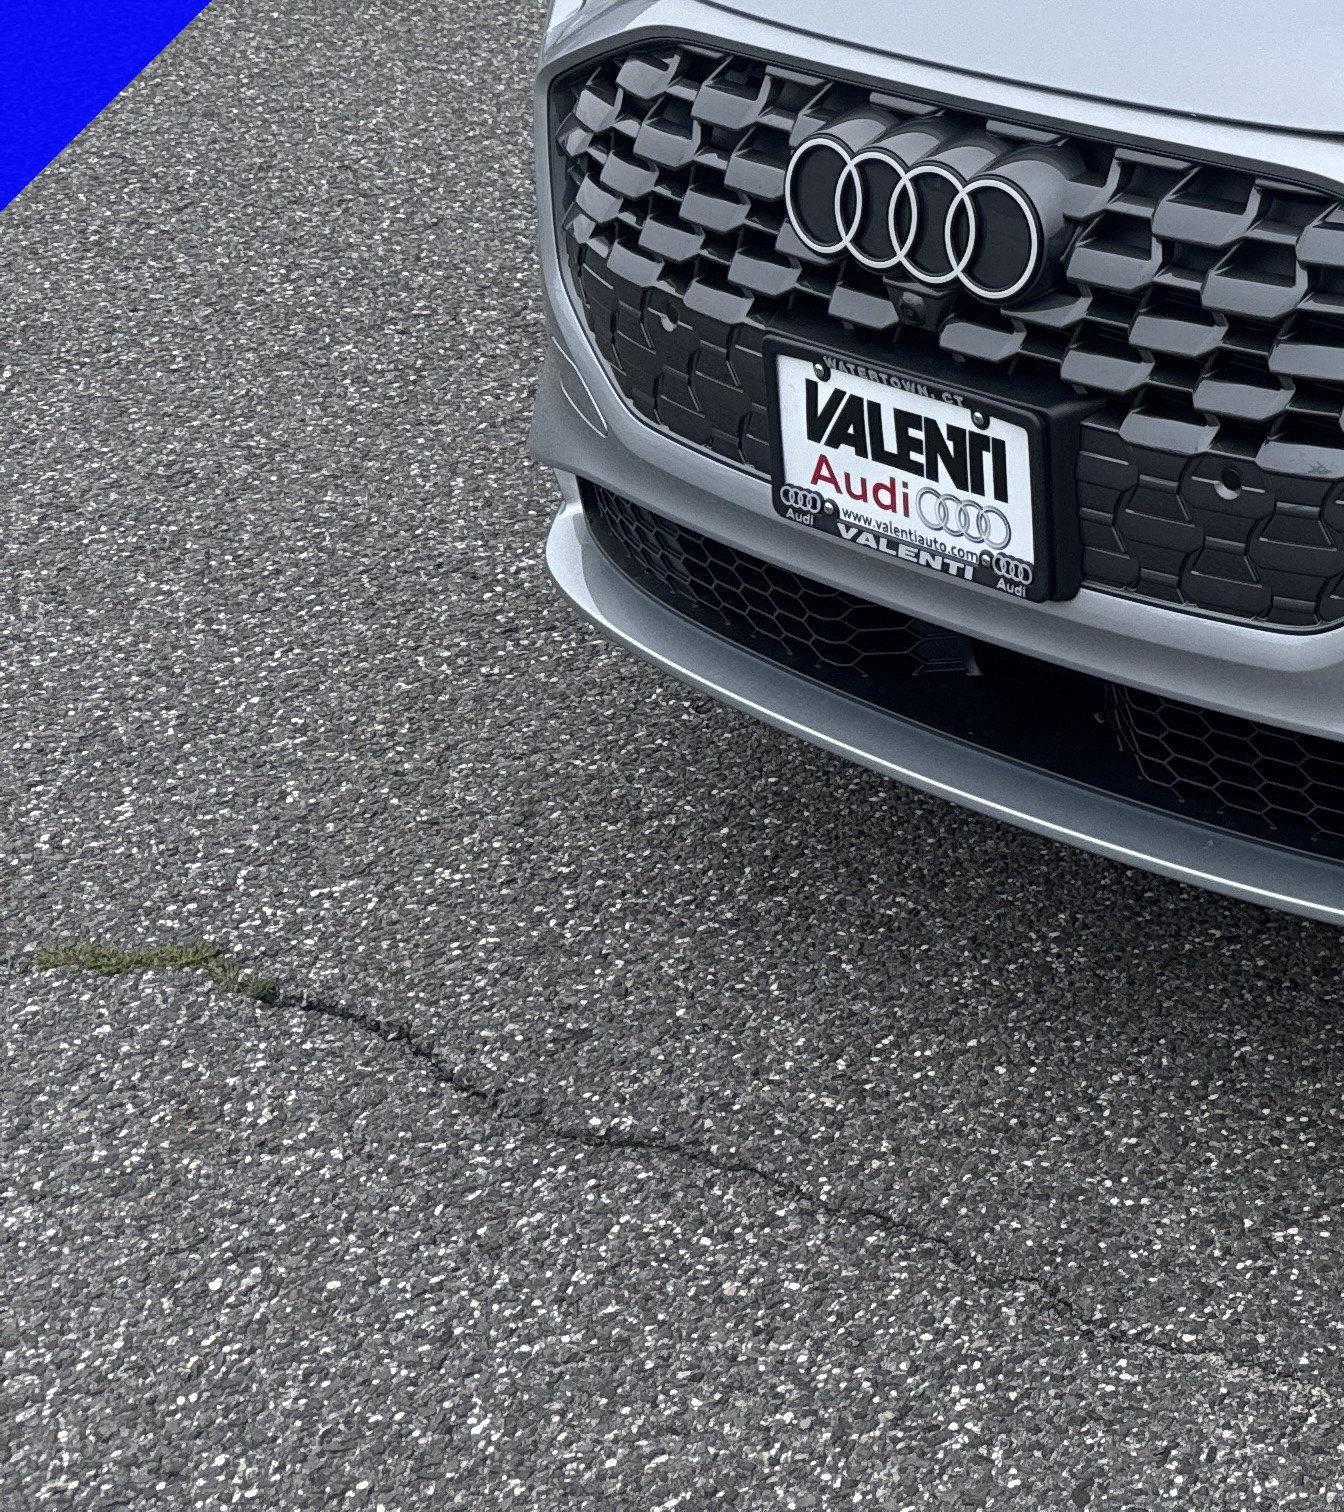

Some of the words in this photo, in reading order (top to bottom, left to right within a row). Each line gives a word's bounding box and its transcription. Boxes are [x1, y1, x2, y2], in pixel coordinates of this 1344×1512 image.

[805, 377, 1009, 503] VALENTI
[810, 454, 910, 518] Audi
[786, 508, 814, 526] Audi
[841, 507, 979, 564] www.valentiauto.com
[837, 522, 974, 580] VALENTI
[996, 578, 1027, 598] Audi
